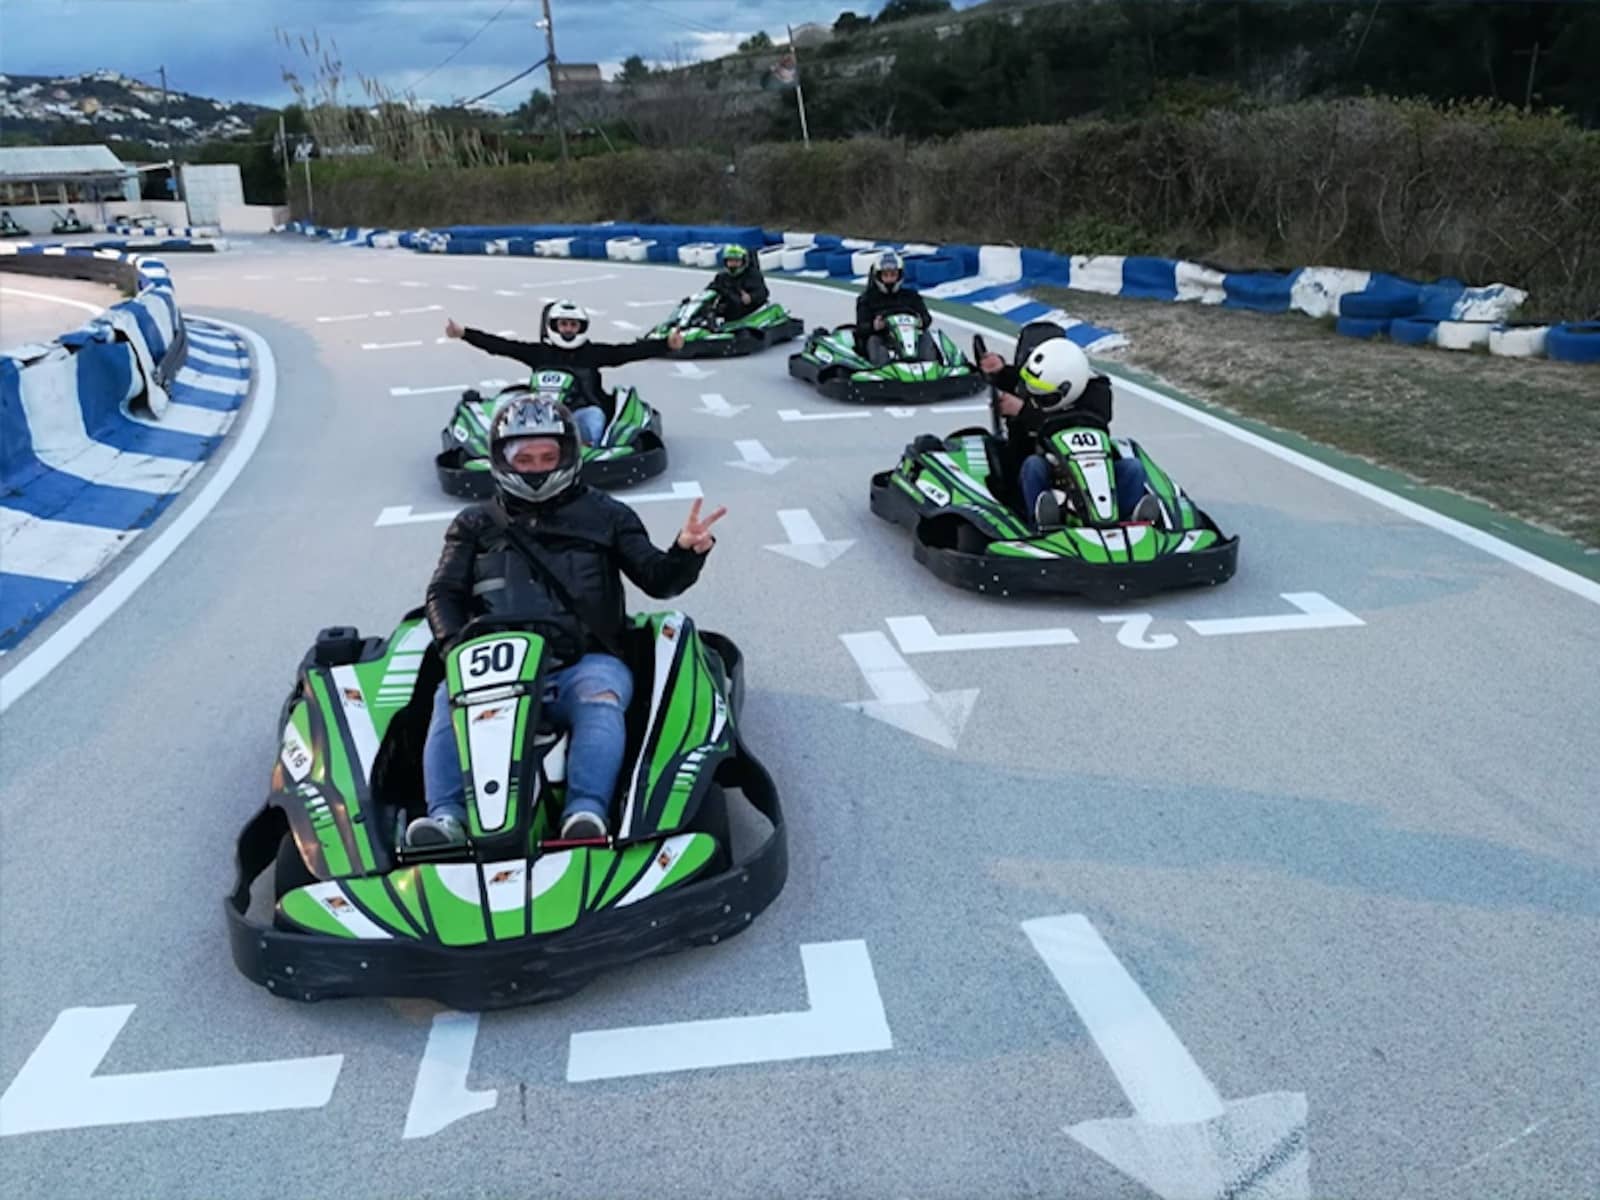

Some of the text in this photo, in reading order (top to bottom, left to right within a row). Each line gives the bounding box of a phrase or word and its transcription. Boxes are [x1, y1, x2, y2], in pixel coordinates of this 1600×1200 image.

[1071, 432, 1097, 446] 40
[1097, 613, 1179, 649] 2
[470, 642, 515, 676] 50
[402, 1010, 498, 1139] 1
